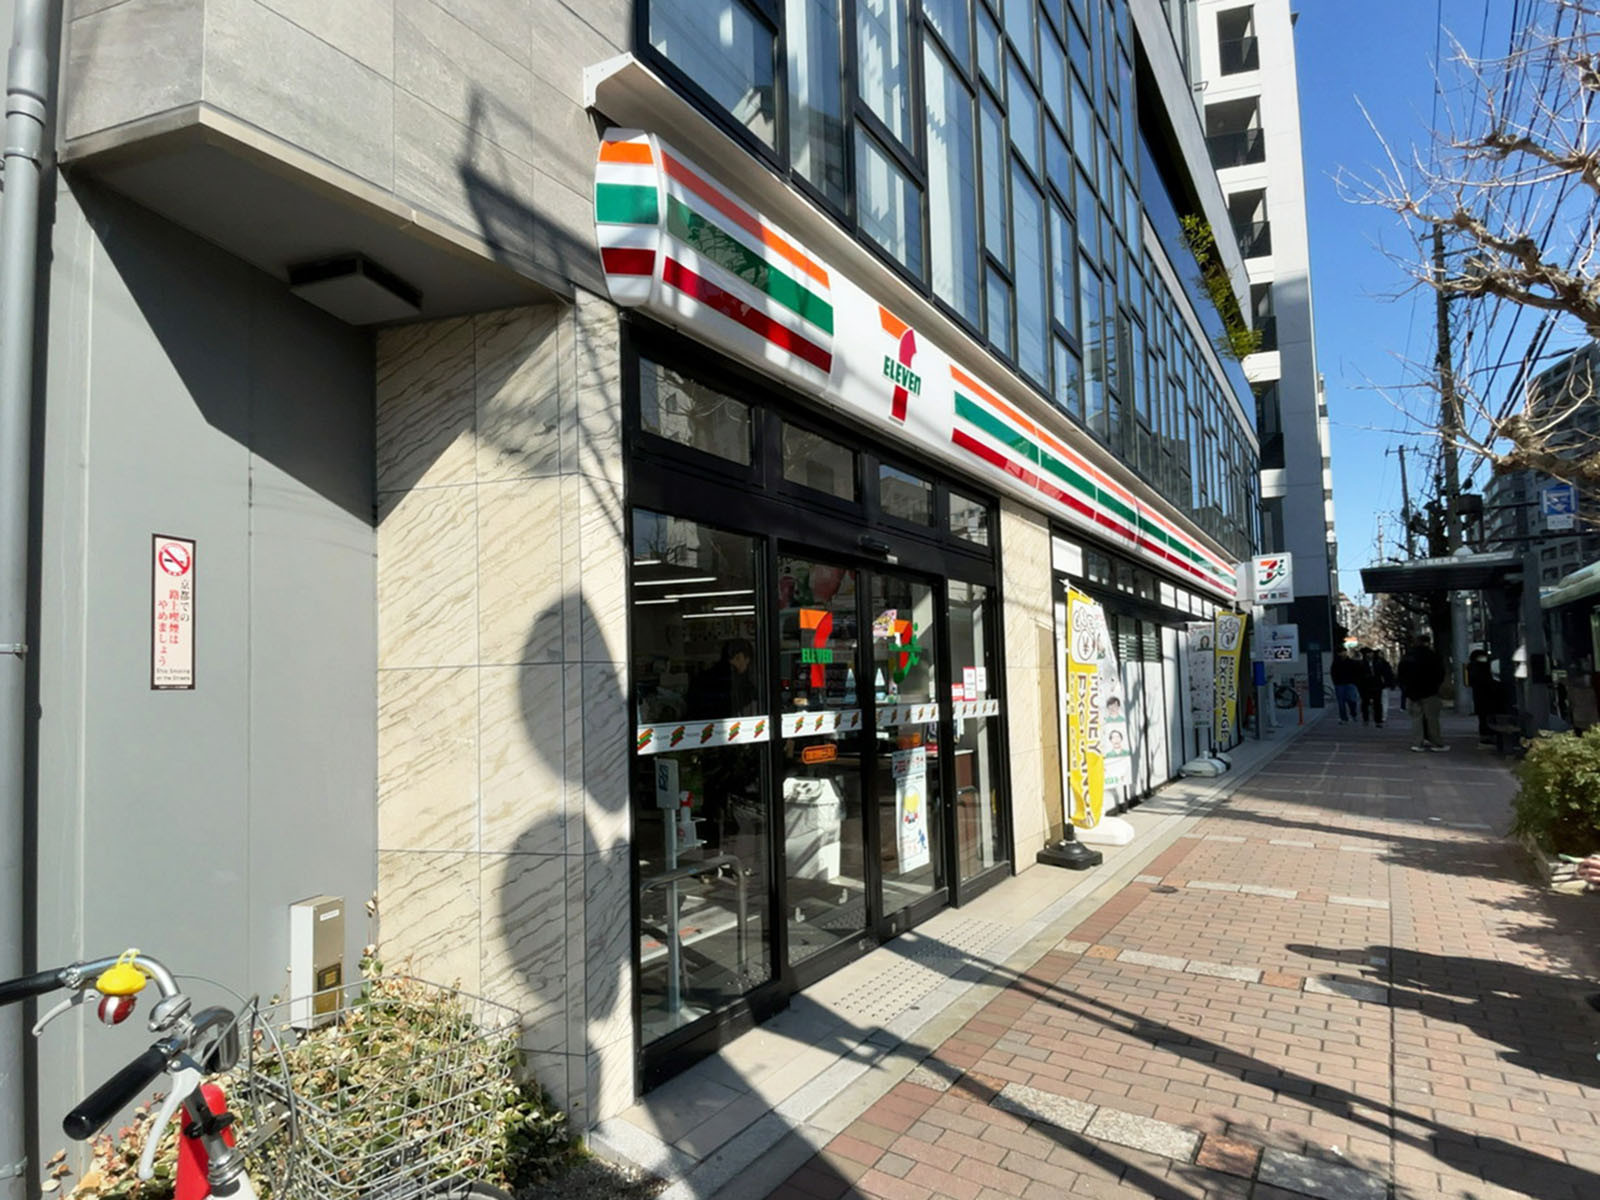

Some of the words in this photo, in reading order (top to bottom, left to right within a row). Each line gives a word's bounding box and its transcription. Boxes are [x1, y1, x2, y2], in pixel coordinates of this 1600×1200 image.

[878, 304, 917, 422] 7
[157, 600, 168, 666] やめましょう
[799, 608, 833, 687] 7
[1219, 656, 1230, 739] EXCHANGE
